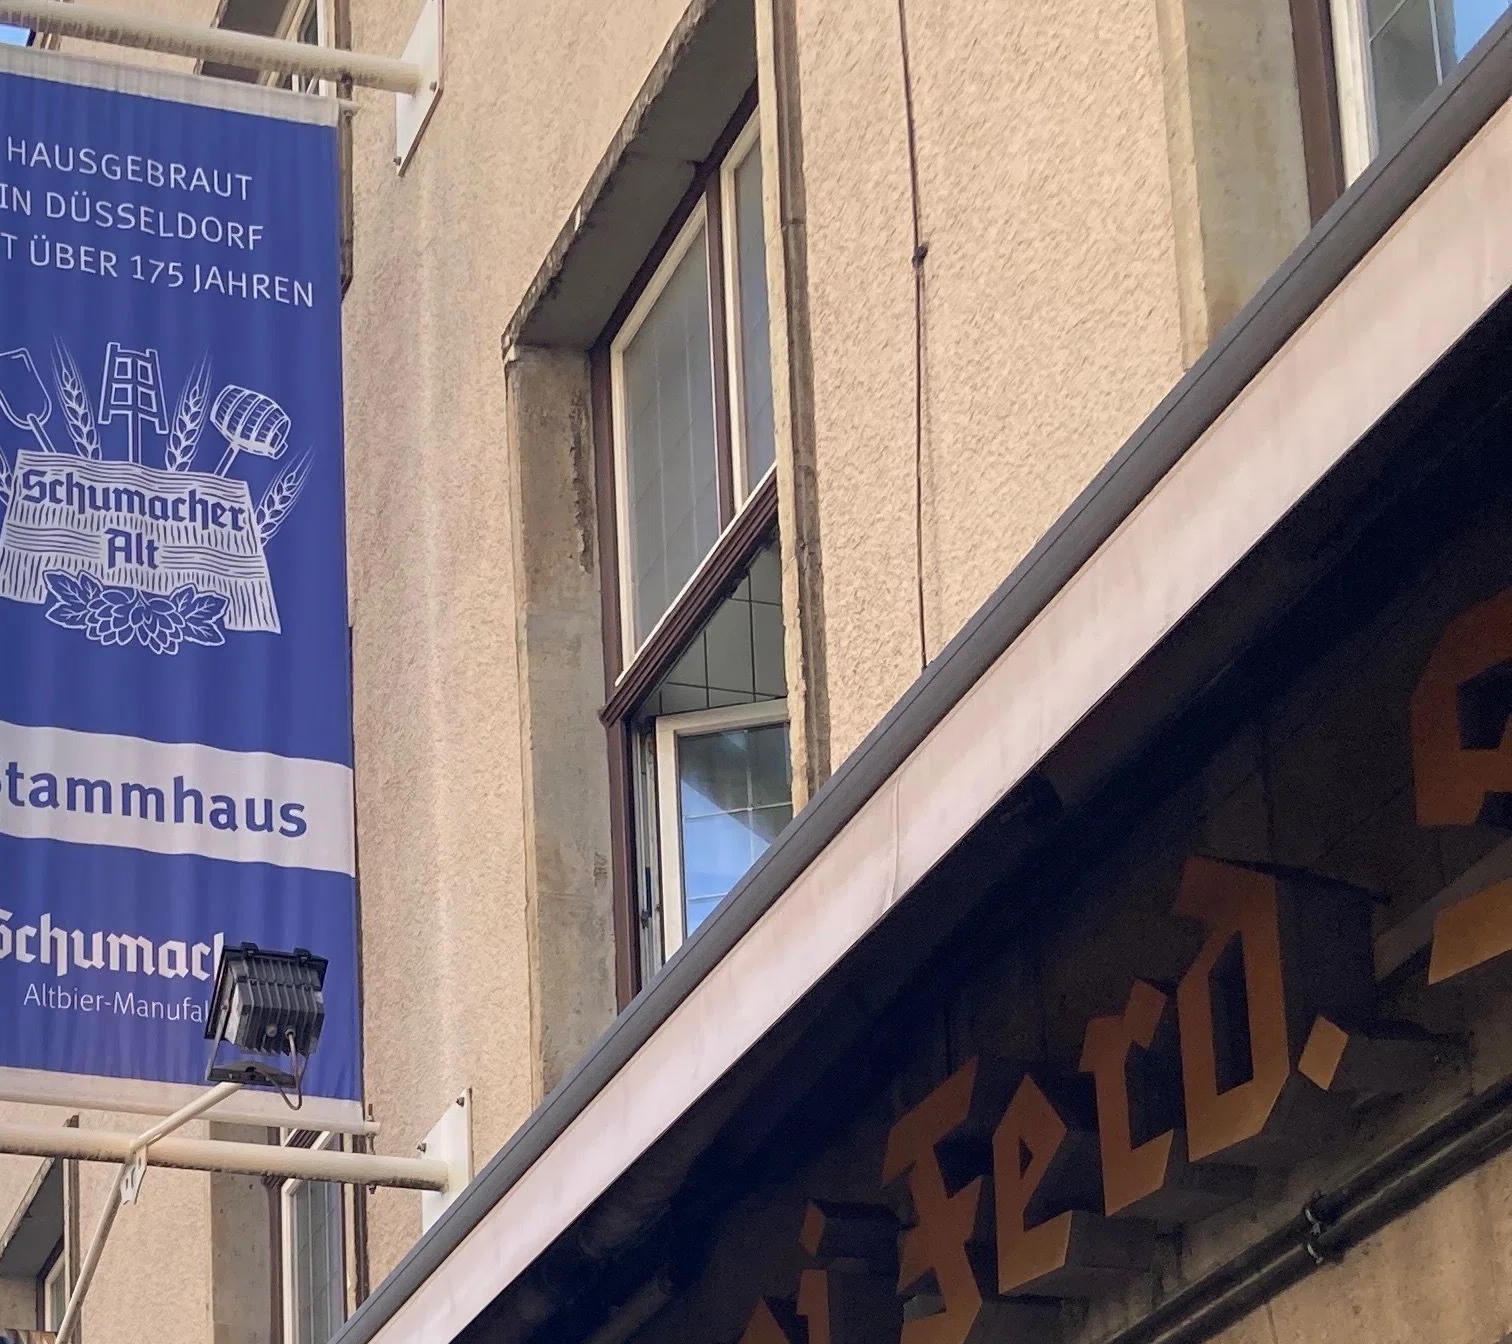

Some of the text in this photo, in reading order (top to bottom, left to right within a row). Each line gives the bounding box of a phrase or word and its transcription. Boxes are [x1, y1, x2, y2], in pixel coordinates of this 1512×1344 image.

[6, 135, 252, 200] HAUSGEBRAUT
[46, 190, 264, 252] DÜSSELDORF
[29, 234, 117, 277] ÜBER
[130, 254, 185, 288] 175
[192, 263, 314, 308] JAHREN
[21, 469, 247, 534] Schumacher
[106, 527, 160, 571] Alt
[23, 982, 209, 1024] Altbier-Manufa
